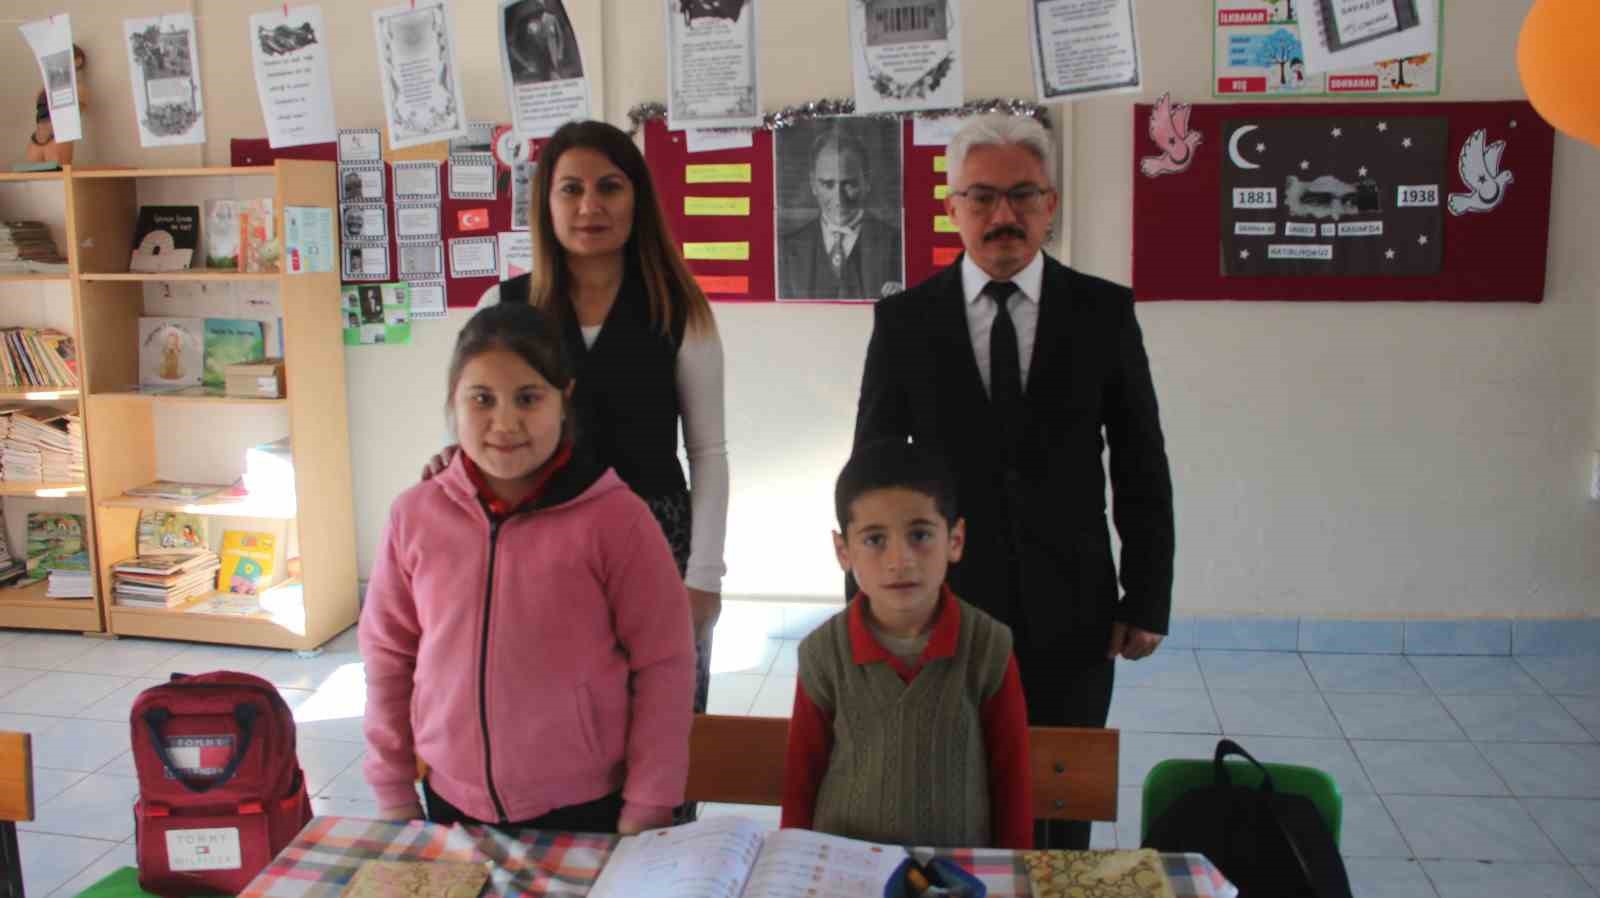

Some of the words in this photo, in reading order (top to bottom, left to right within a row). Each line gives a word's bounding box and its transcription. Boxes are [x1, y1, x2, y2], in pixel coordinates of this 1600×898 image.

[1220, 11, 1265, 24] İLKBAHAR
[1232, 80, 1248, 91] KIŞ
[1331, 77, 1376, 89] SONBAHAR
[1238, 190, 1272, 204] 1881
[1401, 190, 1435, 203] 1938
[176, 738, 223, 746] TOMMY
[176, 833, 226, 845] TOMMY
